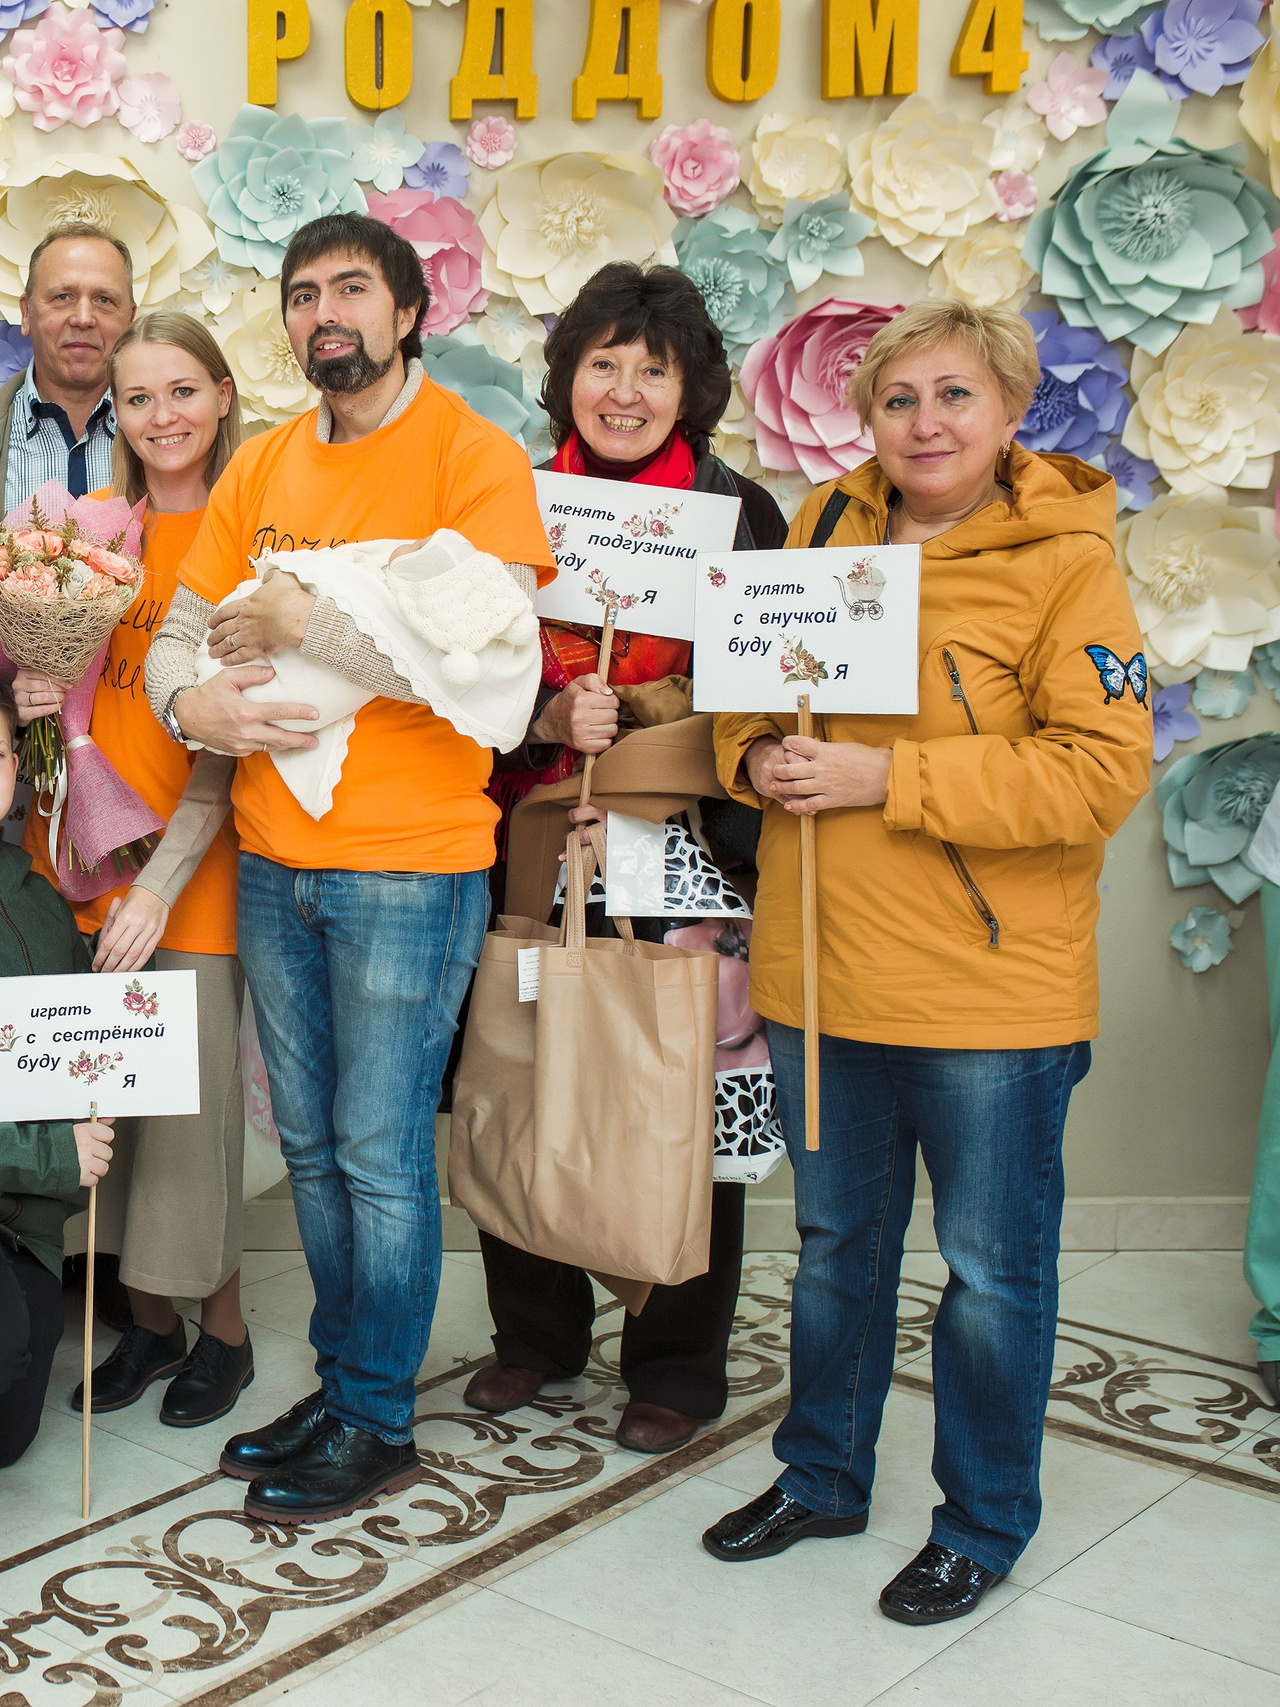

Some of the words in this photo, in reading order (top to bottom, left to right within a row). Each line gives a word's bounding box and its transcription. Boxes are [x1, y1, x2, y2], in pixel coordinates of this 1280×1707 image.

[549, 503, 616, 522] менять
[587, 533, 698, 560] подгузники
[551, 549, 588, 571] уду
[641, 589, 658, 604] Я
[744, 582, 805, 598] гулять
[759, 606, 838, 626] внучкой
[728, 636, 773, 657] буду
[833, 663, 849, 680] Я
[30, 1003, 92, 1020] играть
[52, 1023, 165, 1045] сестрёнкой
[17, 1053, 61, 1073] буду
[122, 1073, 136, 1089] Я
